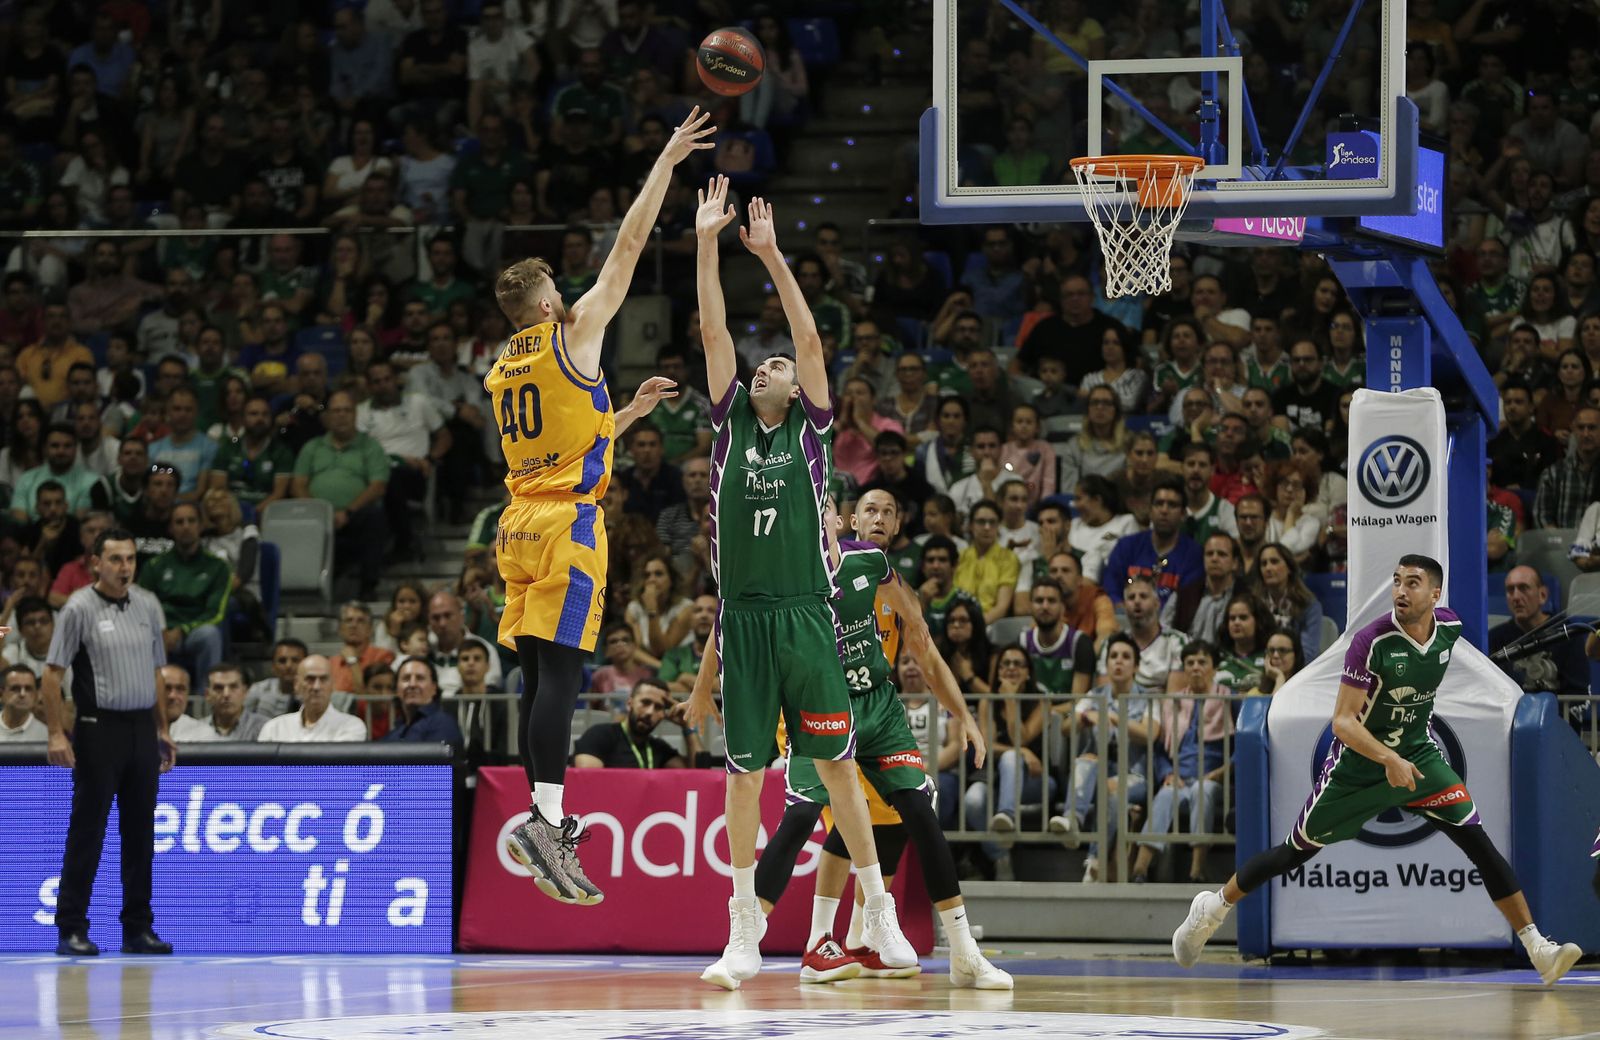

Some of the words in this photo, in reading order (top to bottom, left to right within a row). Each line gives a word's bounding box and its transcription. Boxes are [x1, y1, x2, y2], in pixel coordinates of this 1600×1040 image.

[1340, 156, 1376, 164] endesa
[1417, 182, 1439, 215] star
[501, 382, 543, 443] 40
[764, 451, 792, 466] nicaja
[753, 507, 778, 537] 17
[1351, 515, 1393, 528] Málaga
[1395, 514, 1438, 526] Wagen
[846, 666, 872, 691] 23
[804, 719, 847, 731] worten
[1383, 727, 1404, 747] 3
[883, 753, 923, 765] worten
[496, 790, 824, 878] endes
[1281, 863, 1389, 893] Málaga
[1396, 862, 1483, 892] Wage
